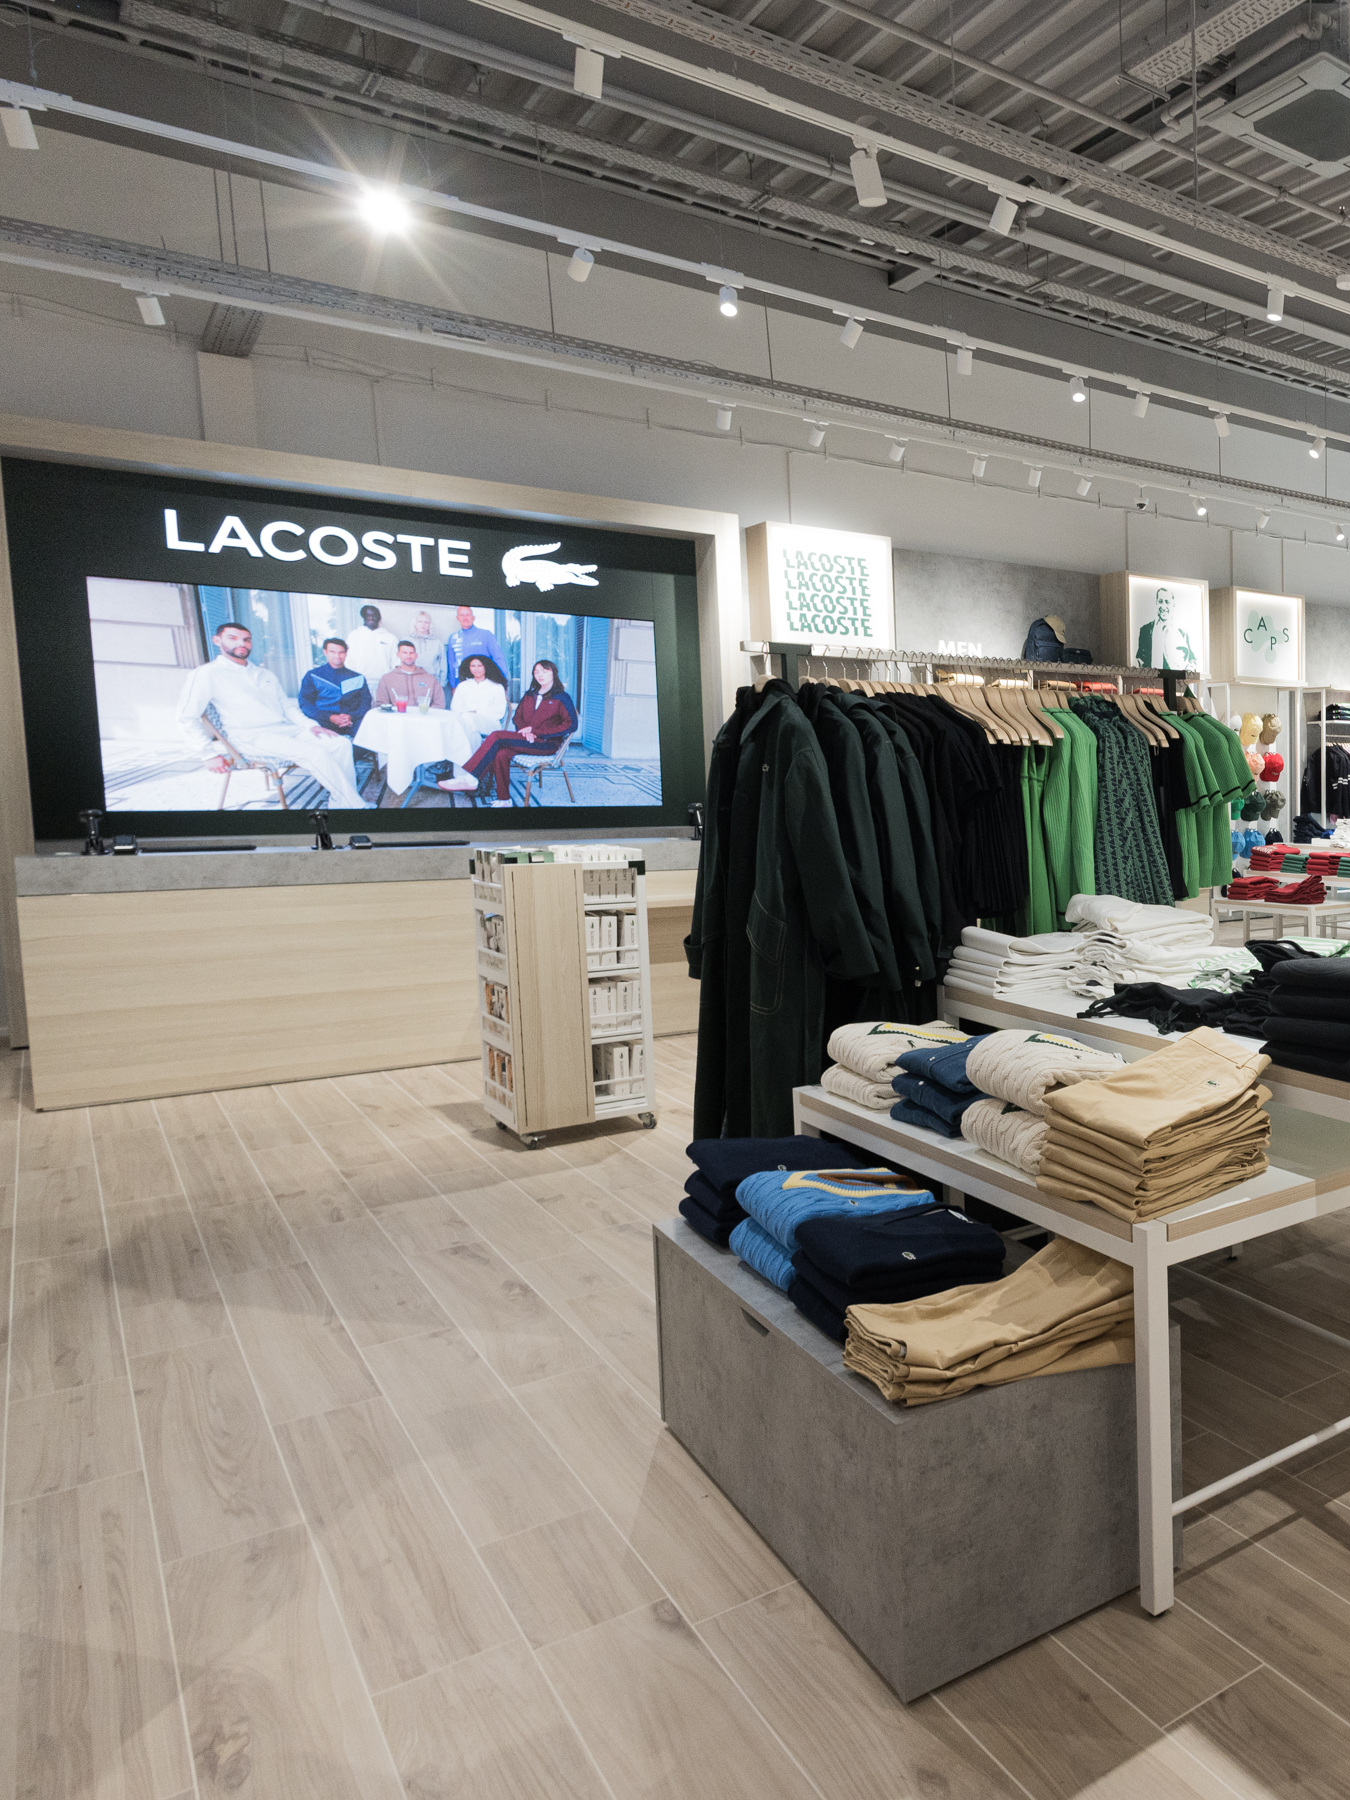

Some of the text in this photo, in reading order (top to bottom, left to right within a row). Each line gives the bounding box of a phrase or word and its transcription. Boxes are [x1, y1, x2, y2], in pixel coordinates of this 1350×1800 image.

[164, 508, 473, 578] LACOSTE
[782, 549, 869, 577] LACOSTE
[784, 569, 870, 597] LACOSTE
[785, 591, 872, 617] LACOSTE
[786, 612, 873, 637] LACOSTE
[937, 639, 983, 657] MEN
